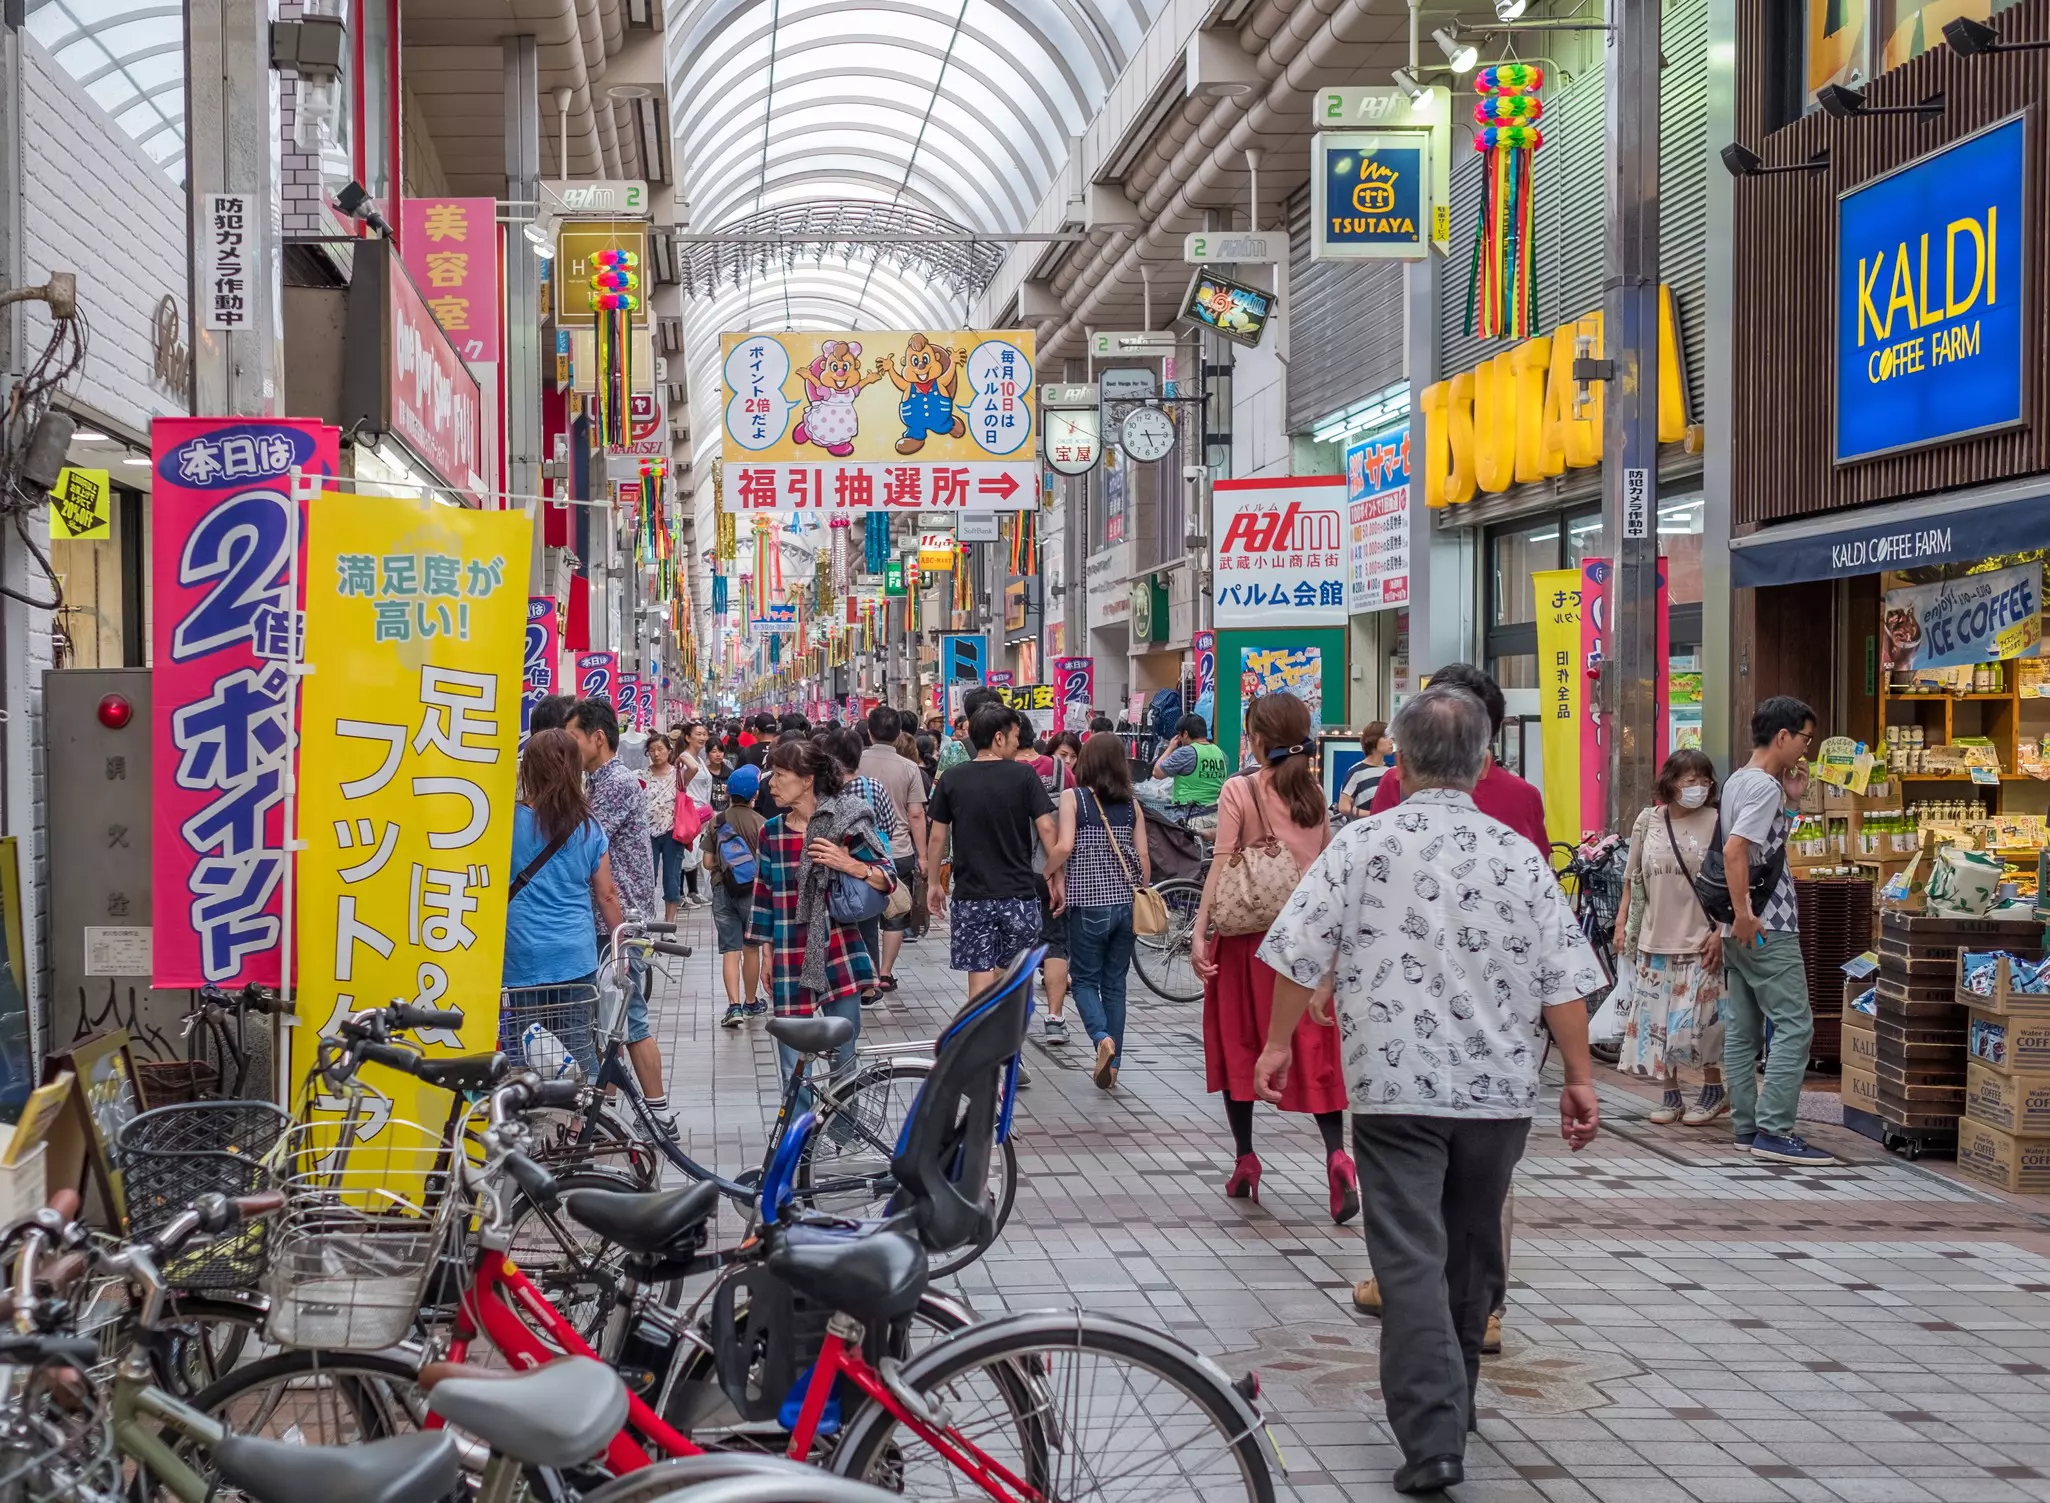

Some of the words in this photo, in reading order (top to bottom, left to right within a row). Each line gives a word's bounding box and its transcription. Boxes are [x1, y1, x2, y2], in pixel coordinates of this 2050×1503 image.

[1327, 95, 1343, 118] 2
[626, 187, 640, 207] 2
[1332, 217, 1415, 234] TSUTAYA
[214, 197, 244, 327] 防犯カメラ作動中
[424, 203, 470, 331] 美容室
[1194, 239, 1207, 257] 2
[1857, 205, 1997, 347] KALDI
[1098, 337, 1109, 352] 2
[1868, 336, 1925, 384] COFFEE
[1932, 319, 1980, 367] FARM
[744, 345, 771, 440] ポイント2倍だよ
[983, 366, 998, 445] パルムの日
[1000, 349, 1016, 429] 毎月10日は
[1047, 388, 1057, 401] 2
[177, 434, 297, 486] 本日は
[1055, 445, 1091, 463] 宝屋
[738, 467, 971, 508] 福引抽選所
[1238, 502, 1278, 512] パルム
[1627, 469, 1643, 537] 防犯カメラ作動中
[963, 527, 992, 535] SoftBank
[1832, 541, 1866, 569] KALDI
[1868, 534, 1912, 562] COFFEE
[1915, 527, 1952, 558] FARM
[336, 552, 506, 598] 満足度が
[920, 556, 952, 564] ABC-MART
[1219, 552, 1340, 571] 武蔵小山商店街
[1217, 579, 1344, 608] パルム会館
[371, 599, 470, 643] 高い!
[1925, 616, 1955, 661] ICE
[1957, 578, 2035, 644] COFFEE
[105, 756, 130, 917] 消火栓
[1980, 1086, 2002, 1101] COFFEE
[1973, 1142, 1996, 1158] COFFEE
